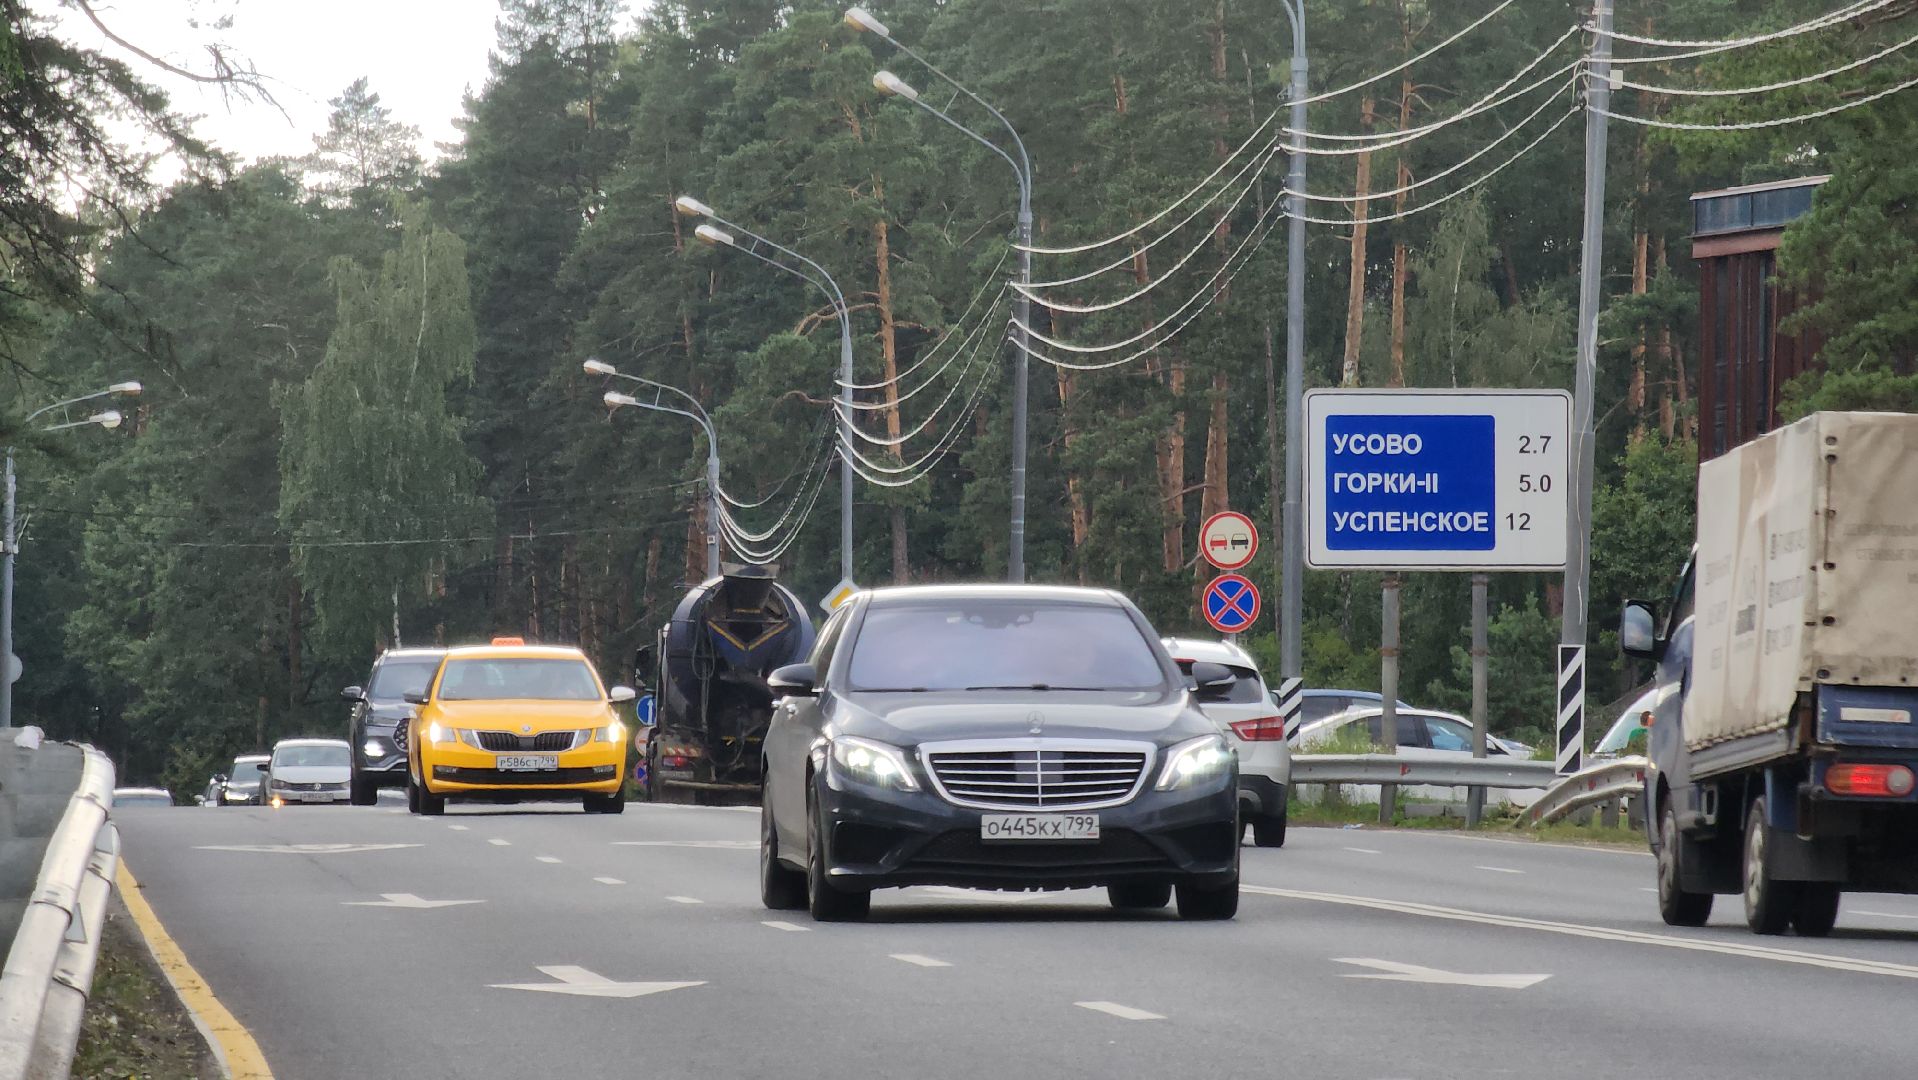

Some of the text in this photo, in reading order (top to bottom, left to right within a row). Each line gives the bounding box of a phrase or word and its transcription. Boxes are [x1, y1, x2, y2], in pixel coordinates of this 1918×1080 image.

[1333, 433, 1552, 455] УСОВО 2.7
[1333, 473, 1551, 493] ГОРКИ-II 5.0
[1333, 511, 1531, 532] УСПЕНСКОЕ 12
[1066, 816, 1094, 831] 799
